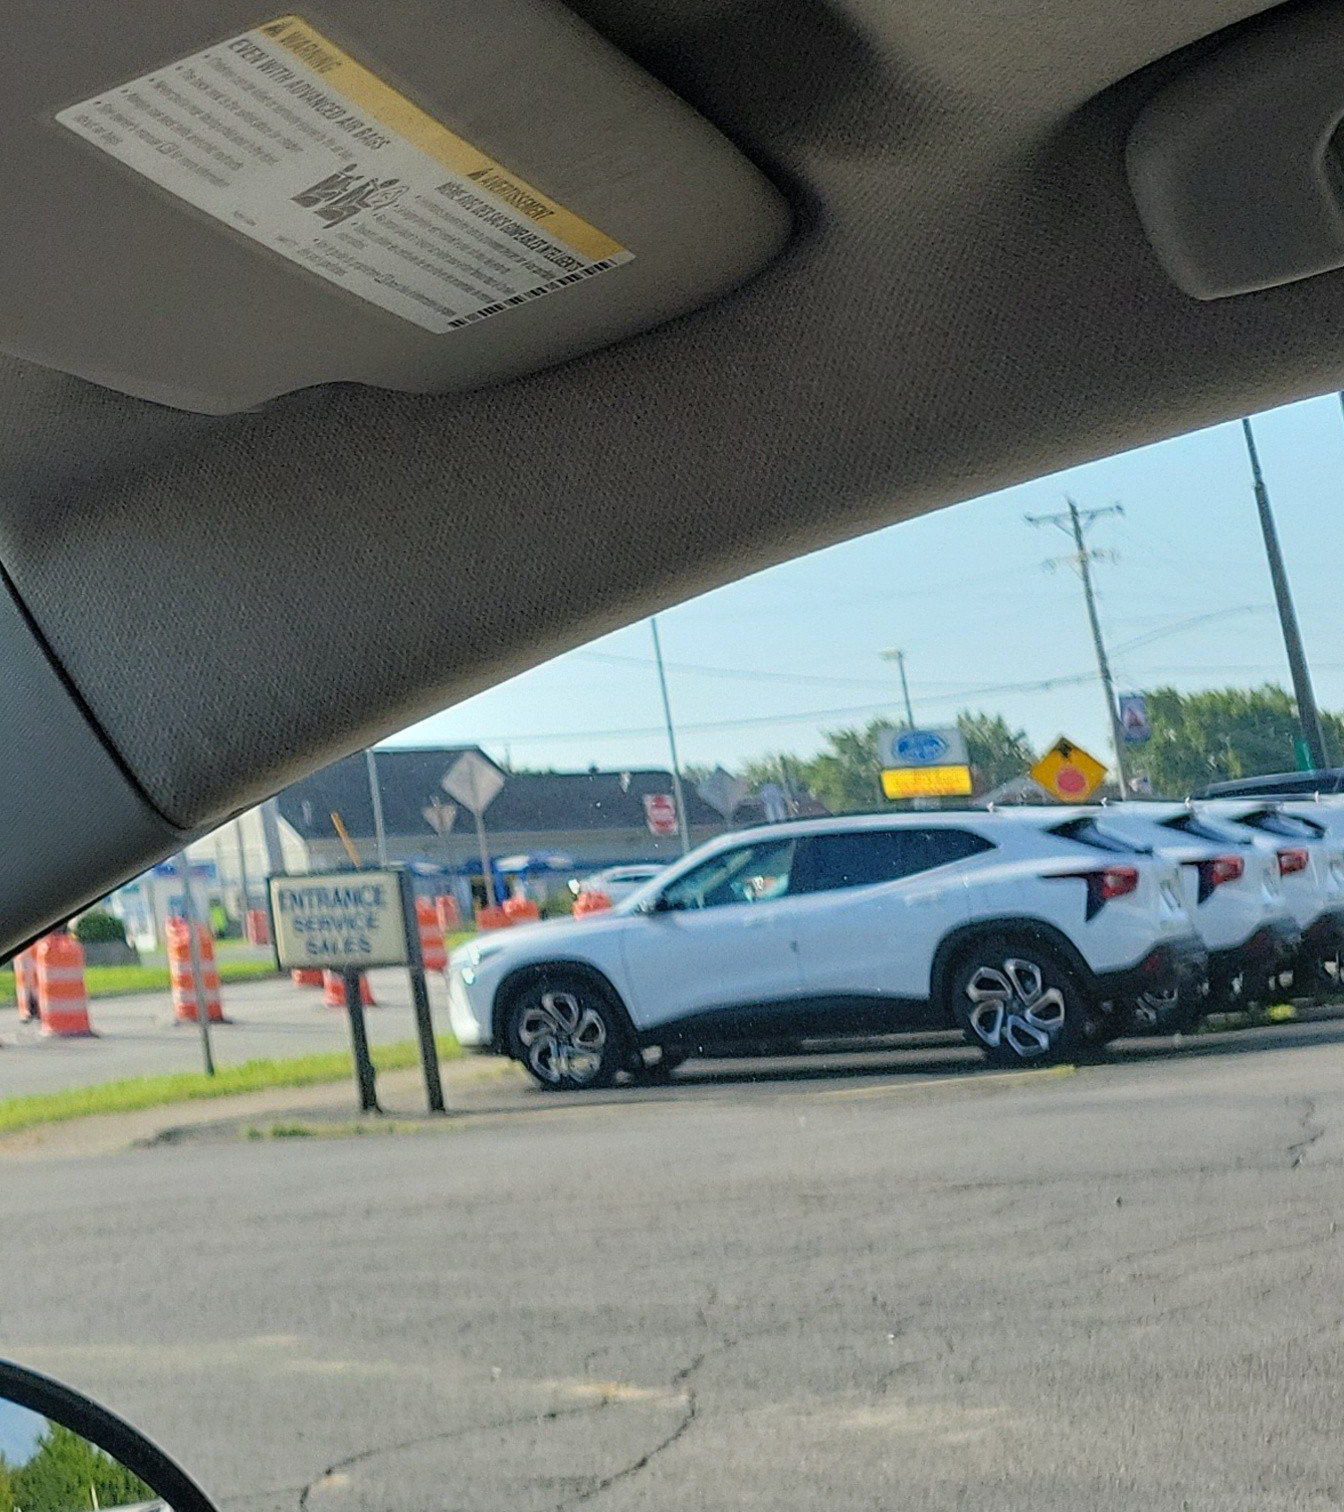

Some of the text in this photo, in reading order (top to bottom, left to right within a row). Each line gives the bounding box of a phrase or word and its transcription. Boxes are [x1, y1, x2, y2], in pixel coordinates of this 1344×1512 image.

[227, 38, 392, 150] EVEN WITH ADVANCED AIR BAGS
[279, 885, 386, 911] ENTRANCE
[293, 914, 377, 934] SERVICE
[305, 935, 372, 956] SALES
